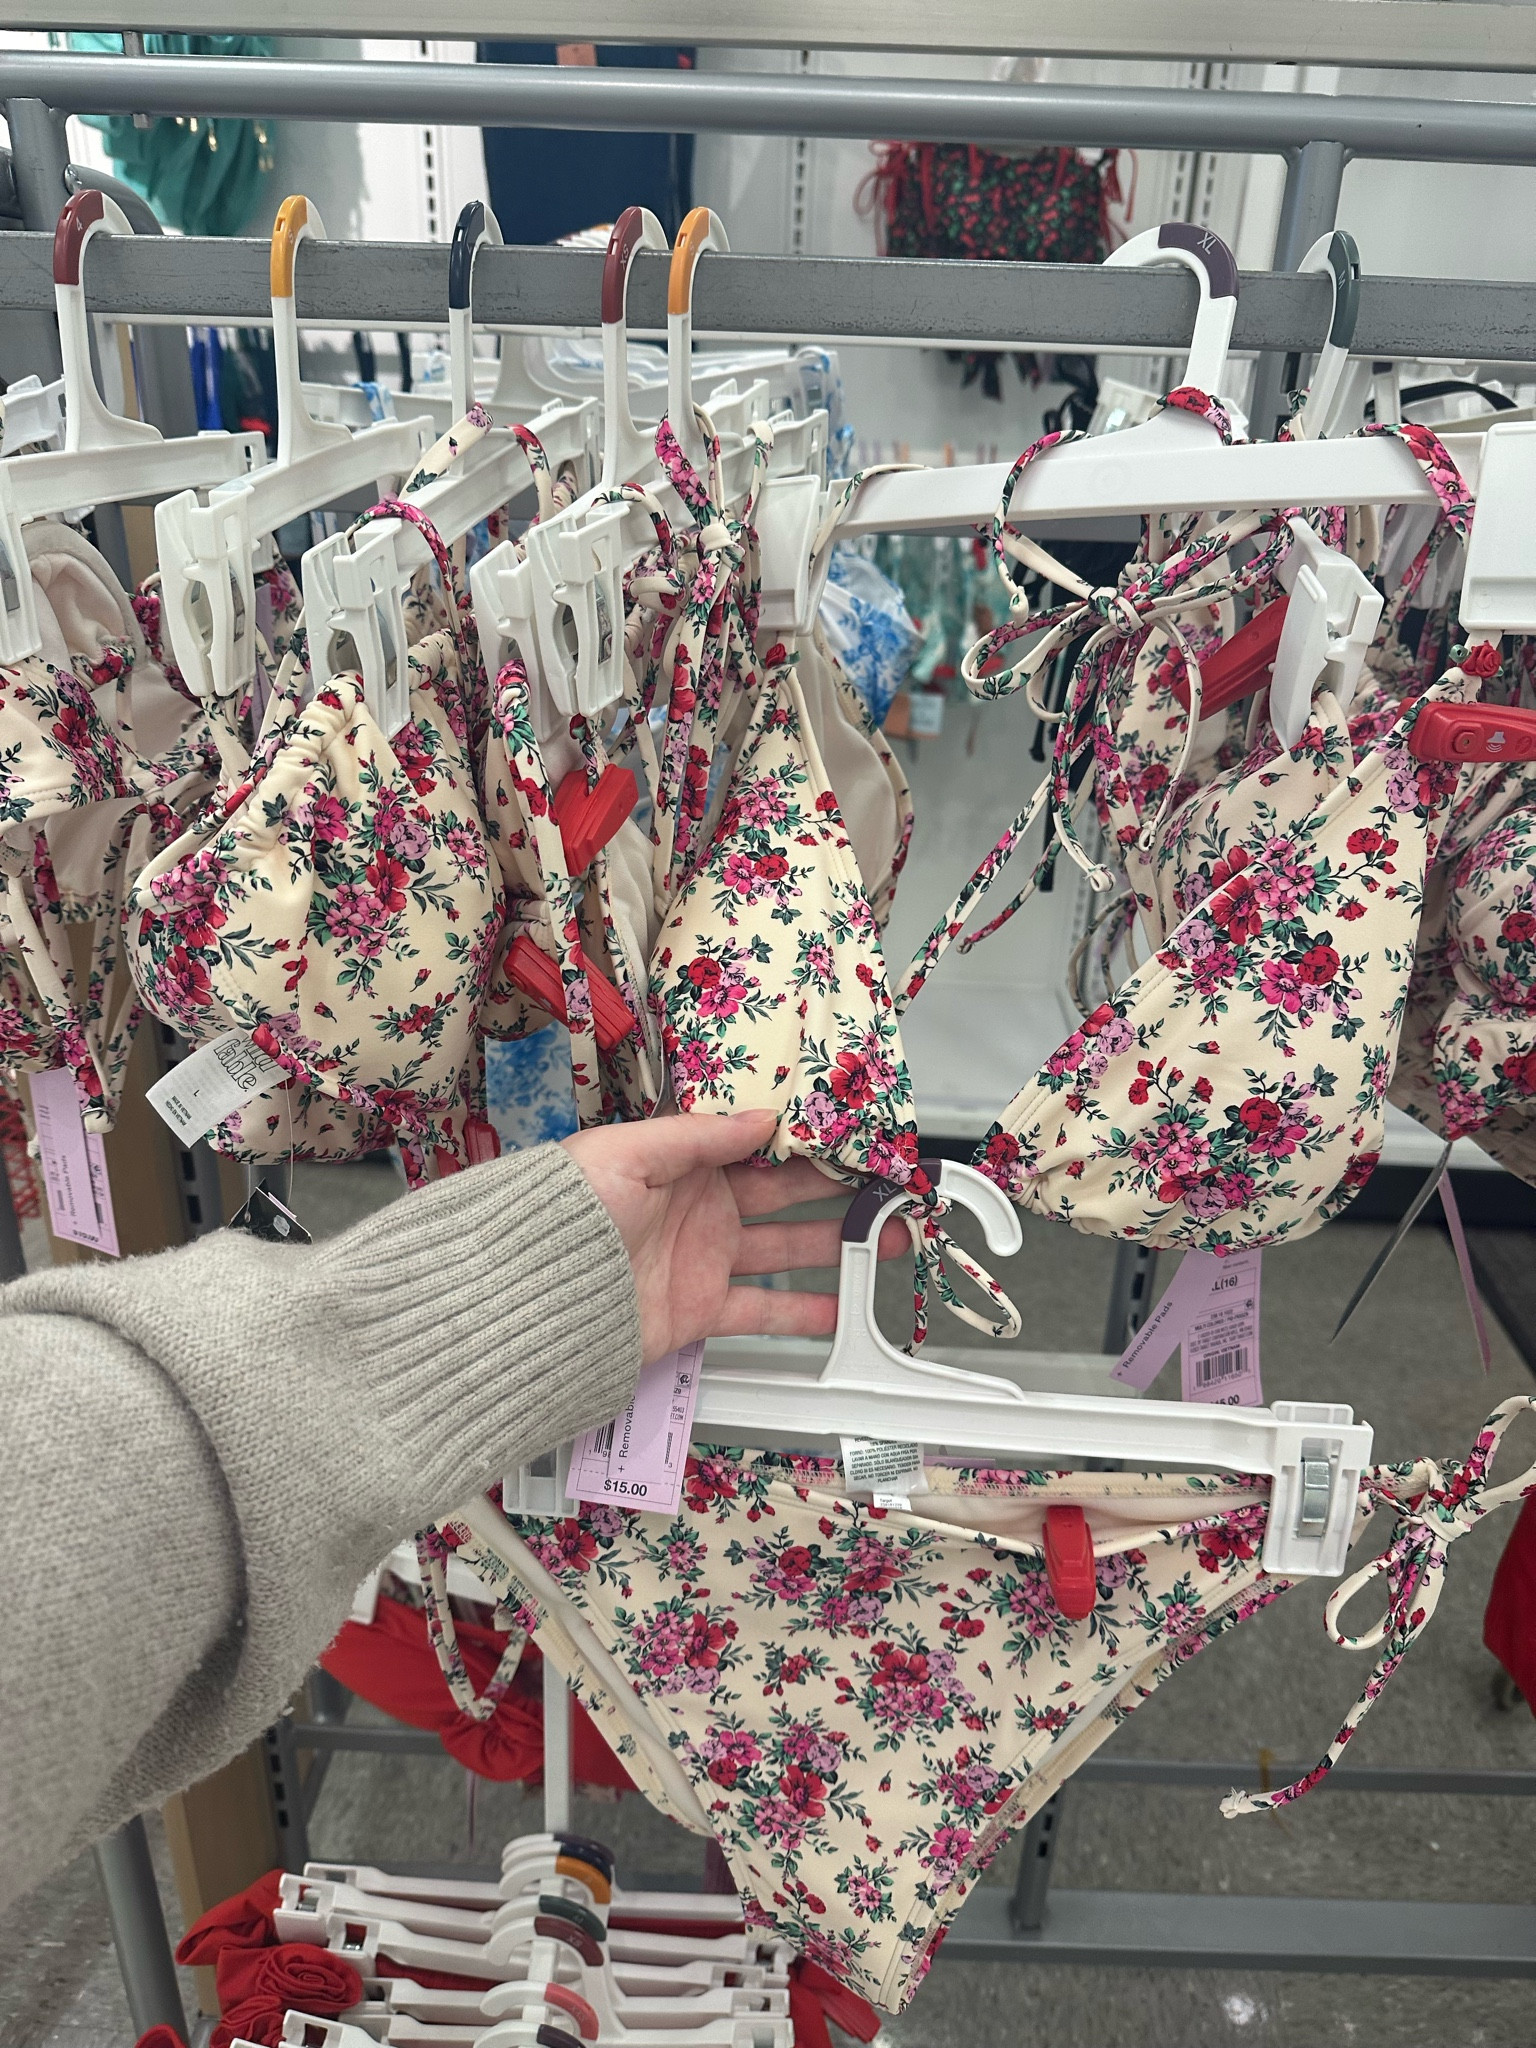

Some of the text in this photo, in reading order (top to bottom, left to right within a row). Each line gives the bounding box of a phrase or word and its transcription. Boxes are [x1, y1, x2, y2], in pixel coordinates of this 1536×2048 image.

[1196, 232, 1217, 255] XL
[620, 243, 629, 271] XS
[872, 1182, 897, 1202] XL
[1211, 1275, 1238, 1292] L(16)
[1122, 1323, 1158, 1369] Removable
[1154, 1301, 1173, 1323] Pads
[618, 1395, 635, 1458] Removab
[603, 1479, 648, 1497] $15.00
